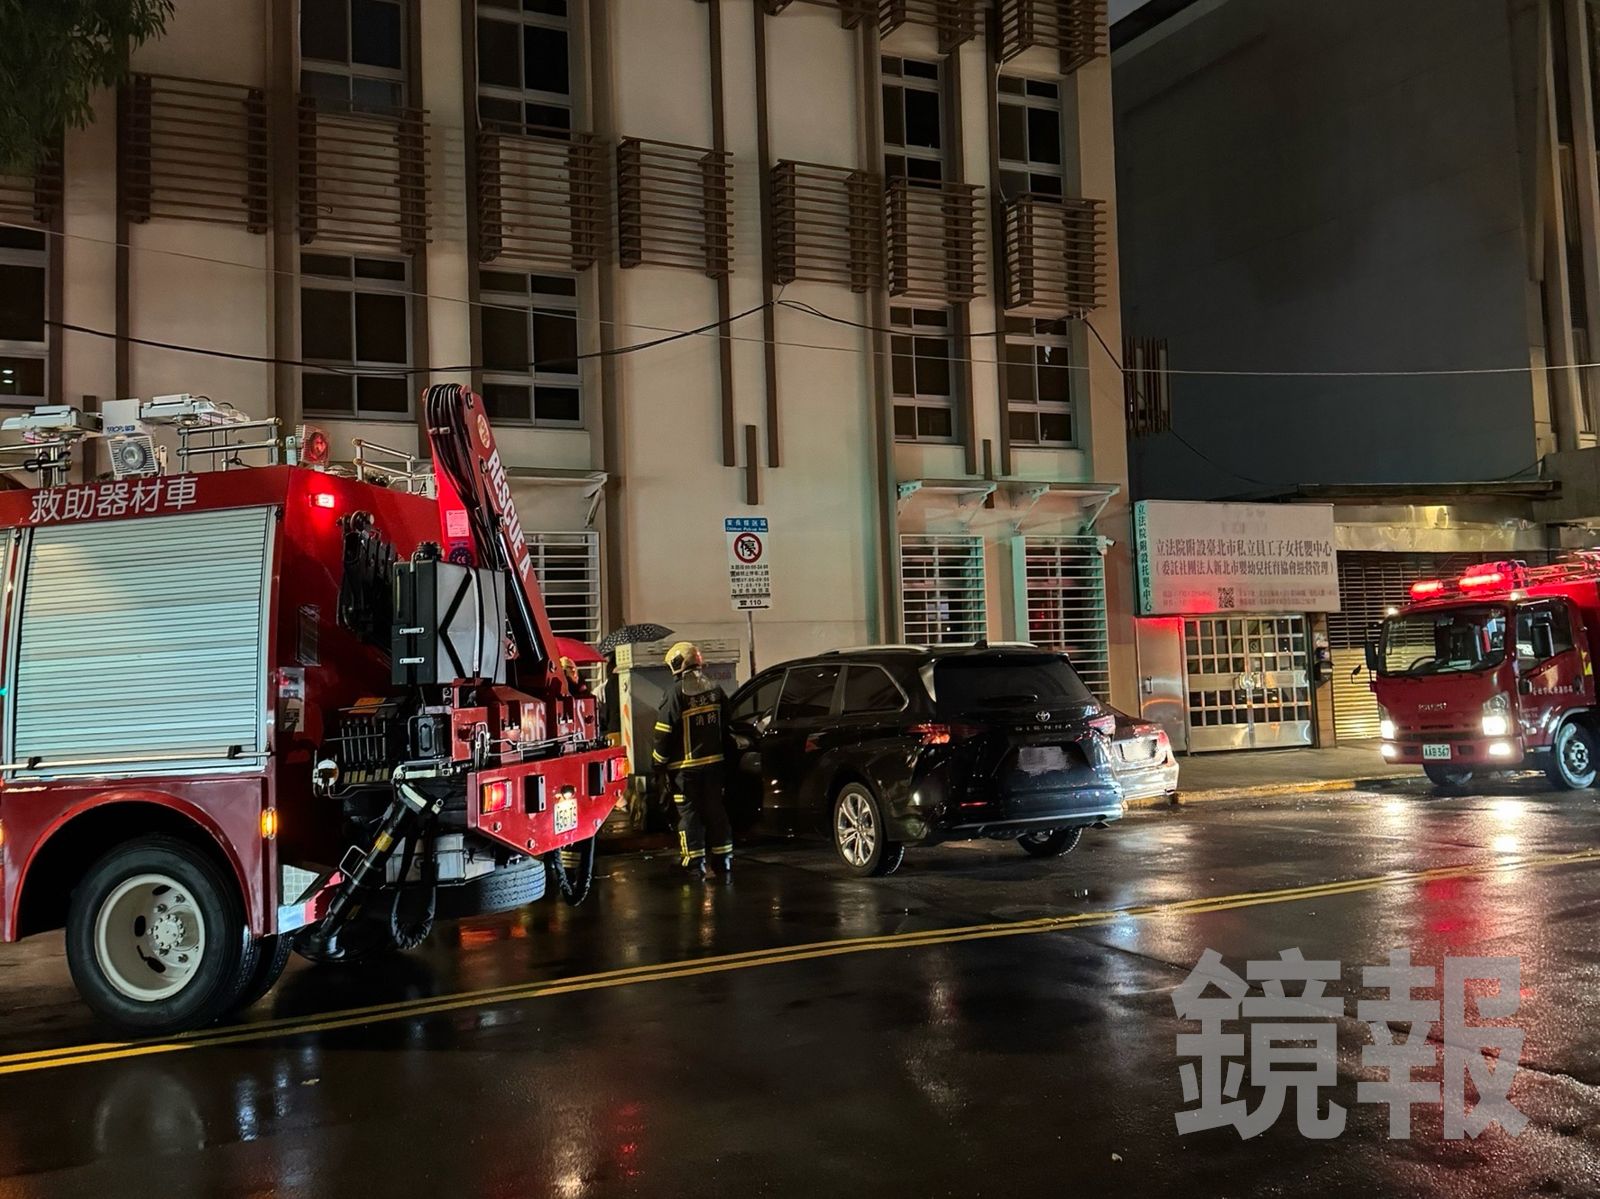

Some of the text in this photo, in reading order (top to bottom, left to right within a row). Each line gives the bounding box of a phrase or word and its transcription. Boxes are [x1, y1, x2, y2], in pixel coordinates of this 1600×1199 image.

[28, 476, 199, 524] 救助器材車
[487, 449, 525, 557] RESCUE
[739, 539, 756, 557] 停
[1137, 504, 1152, 612] 立法院附設托嬰中心
[695, 713, 717, 726] 消防
[1015, 723, 1073, 732] SIENNA
